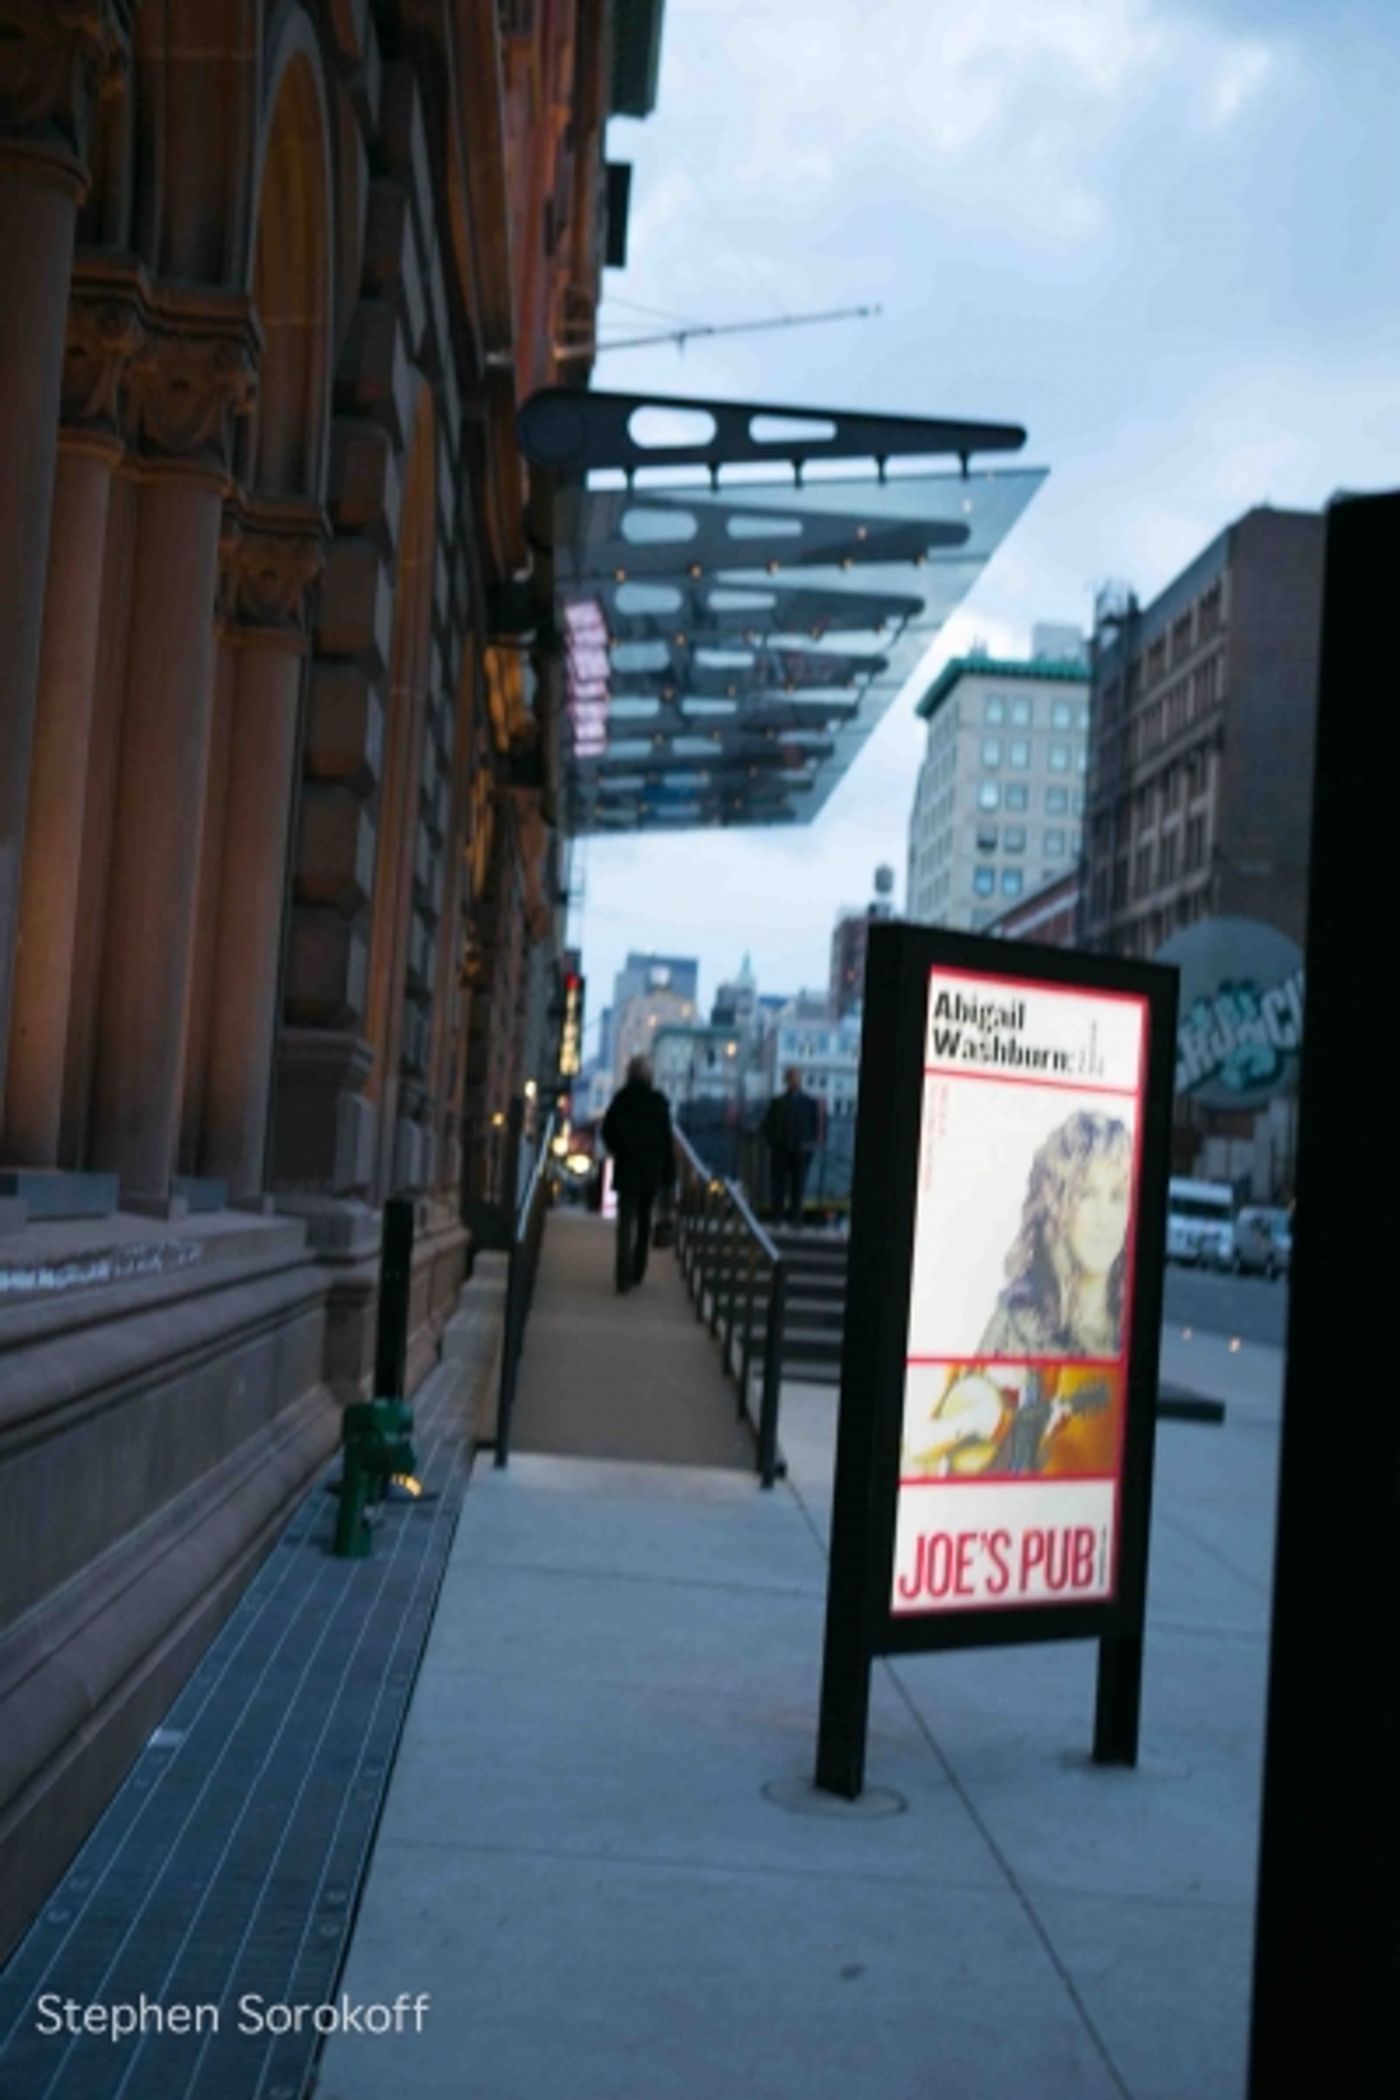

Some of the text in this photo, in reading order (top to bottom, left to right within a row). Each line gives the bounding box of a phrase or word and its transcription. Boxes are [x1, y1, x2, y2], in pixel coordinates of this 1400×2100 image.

[934, 990, 1025, 1033] Abigail
[899, 1528, 1011, 1600] JOE'S
[1020, 1525, 1096, 1593] PUB
